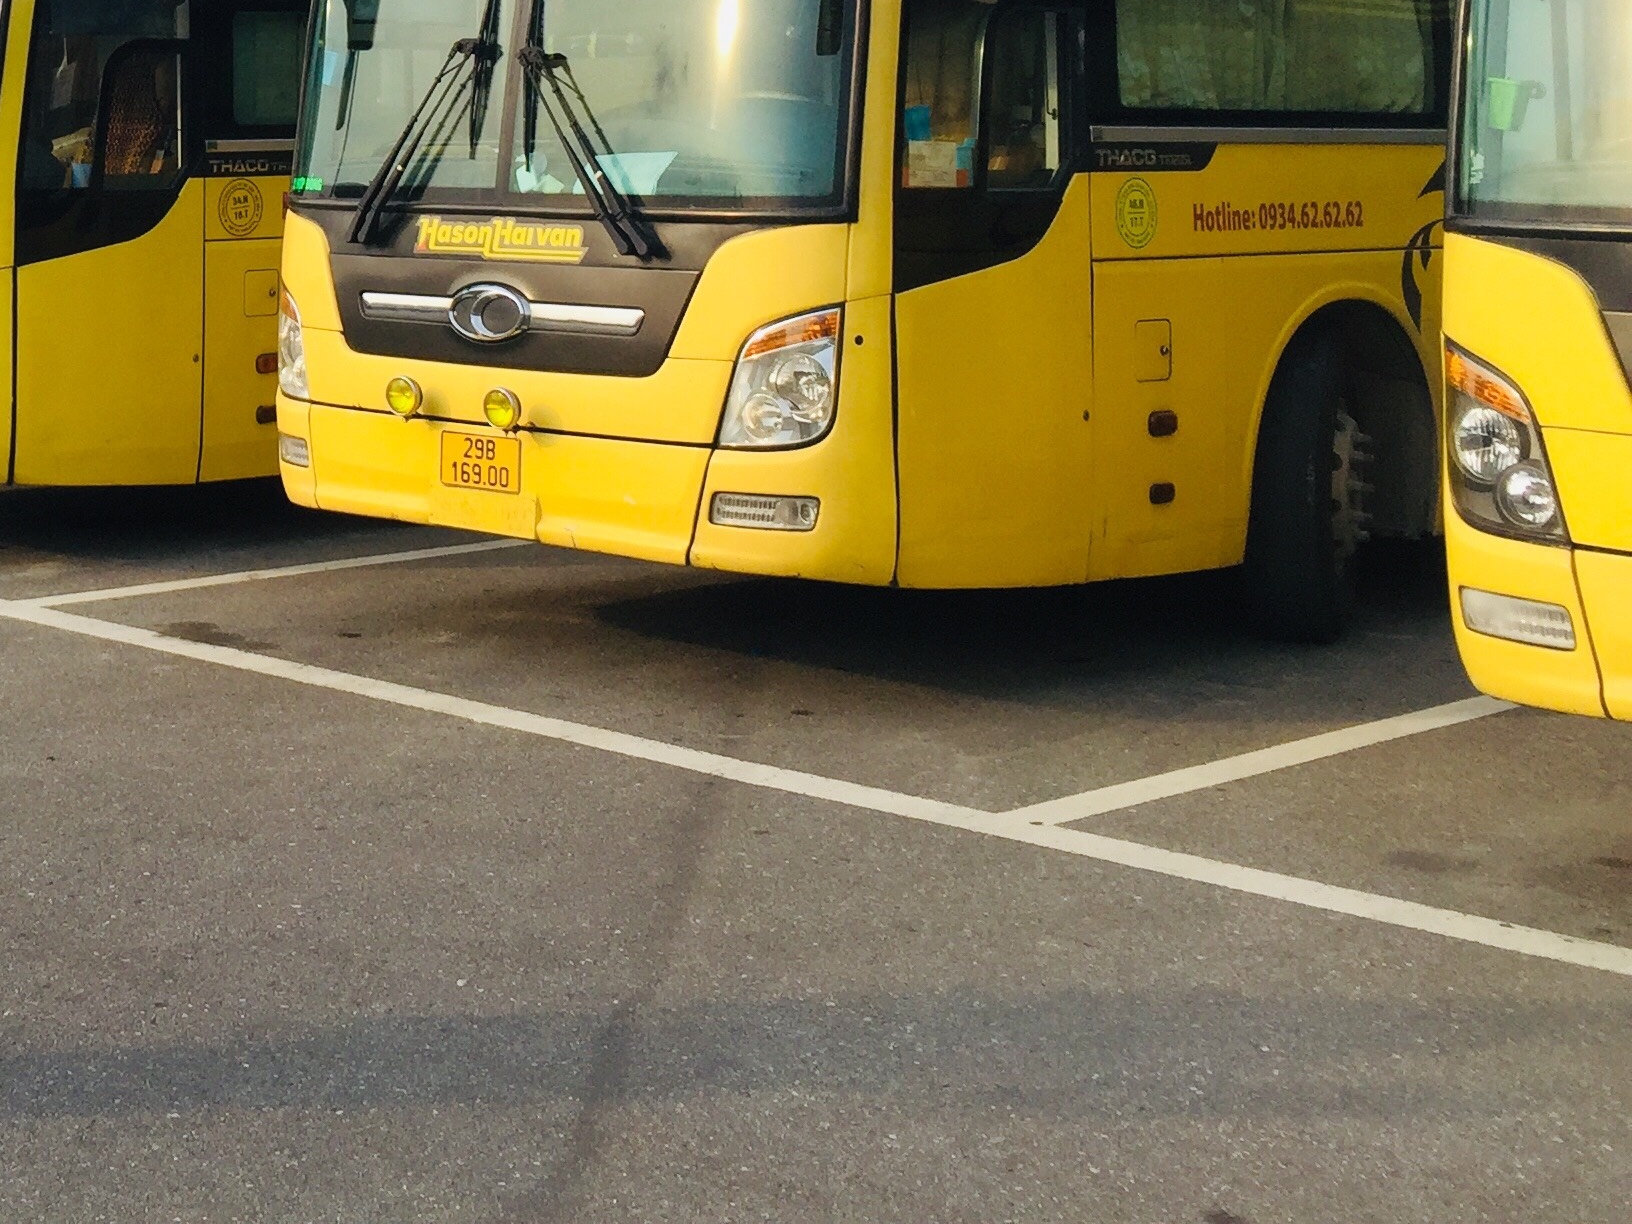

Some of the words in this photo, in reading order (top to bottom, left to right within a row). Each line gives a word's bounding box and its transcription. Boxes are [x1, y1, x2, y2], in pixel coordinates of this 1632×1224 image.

[208, 159, 270, 173] THACO
[1095, 149, 1157, 167] THACO
[1193, 201, 1256, 232] Hotline:
[1258, 200, 1364, 231] 0934.62.62.62
[463, 437, 496, 461] 29B
[451, 461, 509, 488] 169.00
